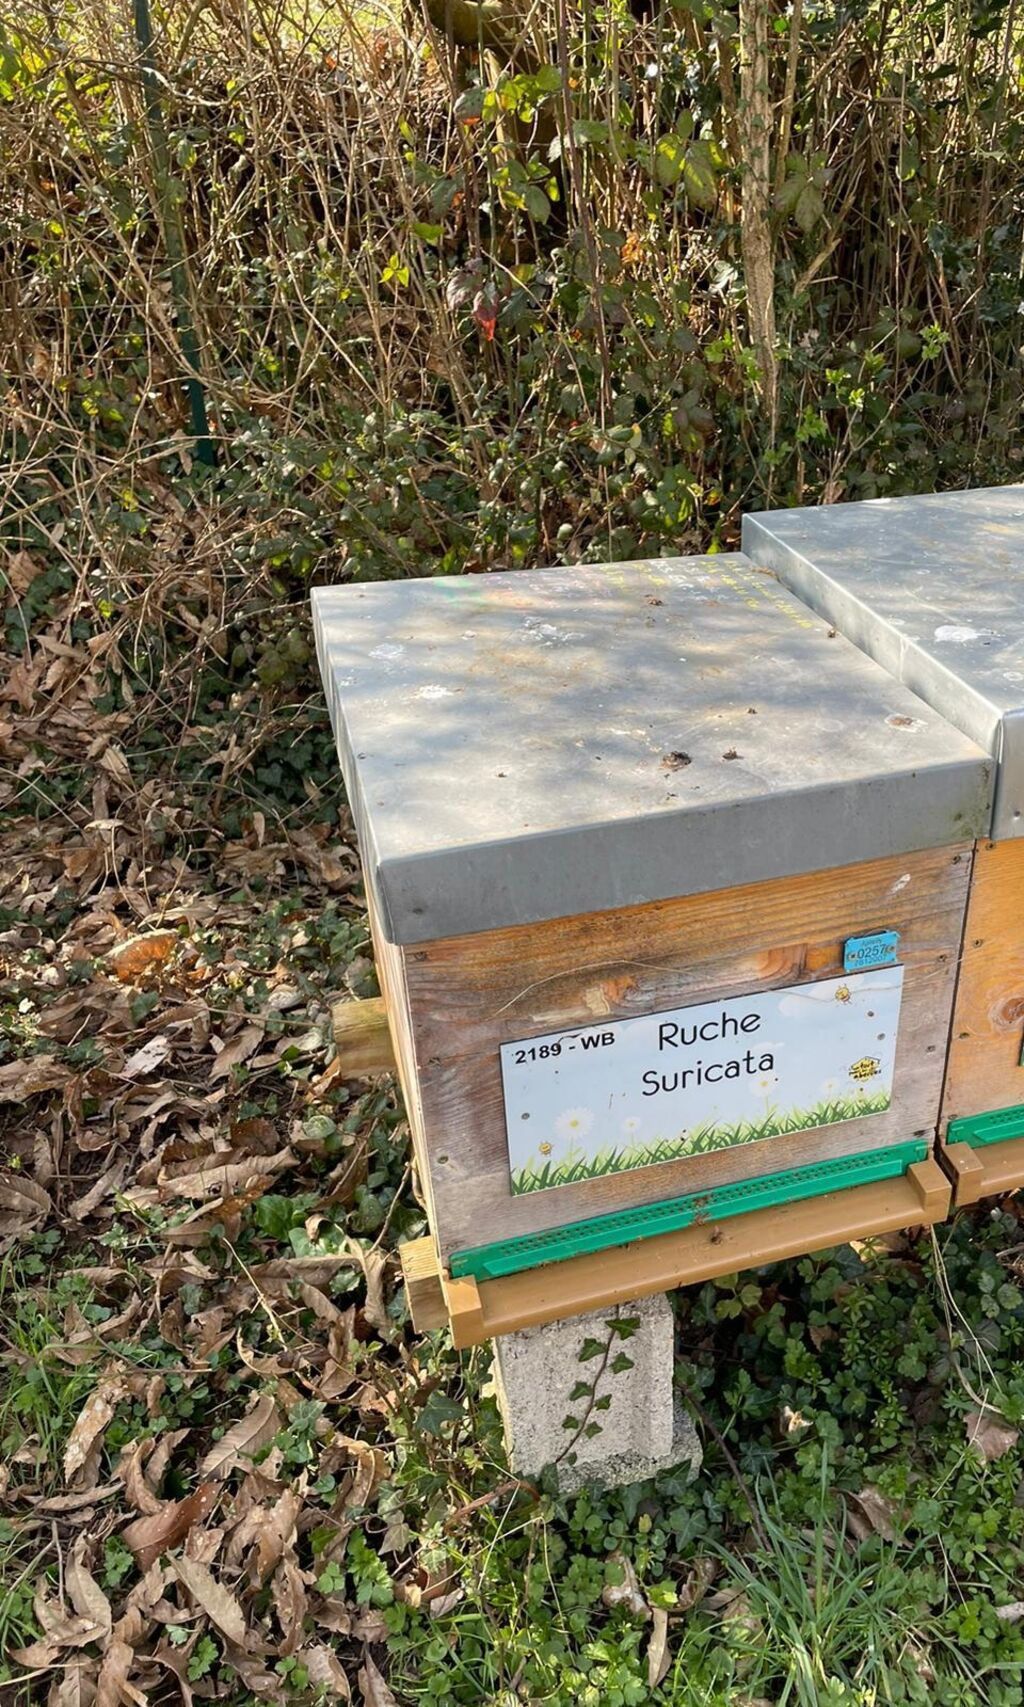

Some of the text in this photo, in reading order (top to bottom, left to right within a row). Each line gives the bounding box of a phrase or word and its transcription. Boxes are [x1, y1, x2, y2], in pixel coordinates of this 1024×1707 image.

[857, 944, 887, 959] 0257
[515, 1043, 562, 1064] 2189
[580, 1032, 615, 1050] WB
[659, 1012, 761, 1050] Ruche
[642, 1050, 774, 1096] Suricata
